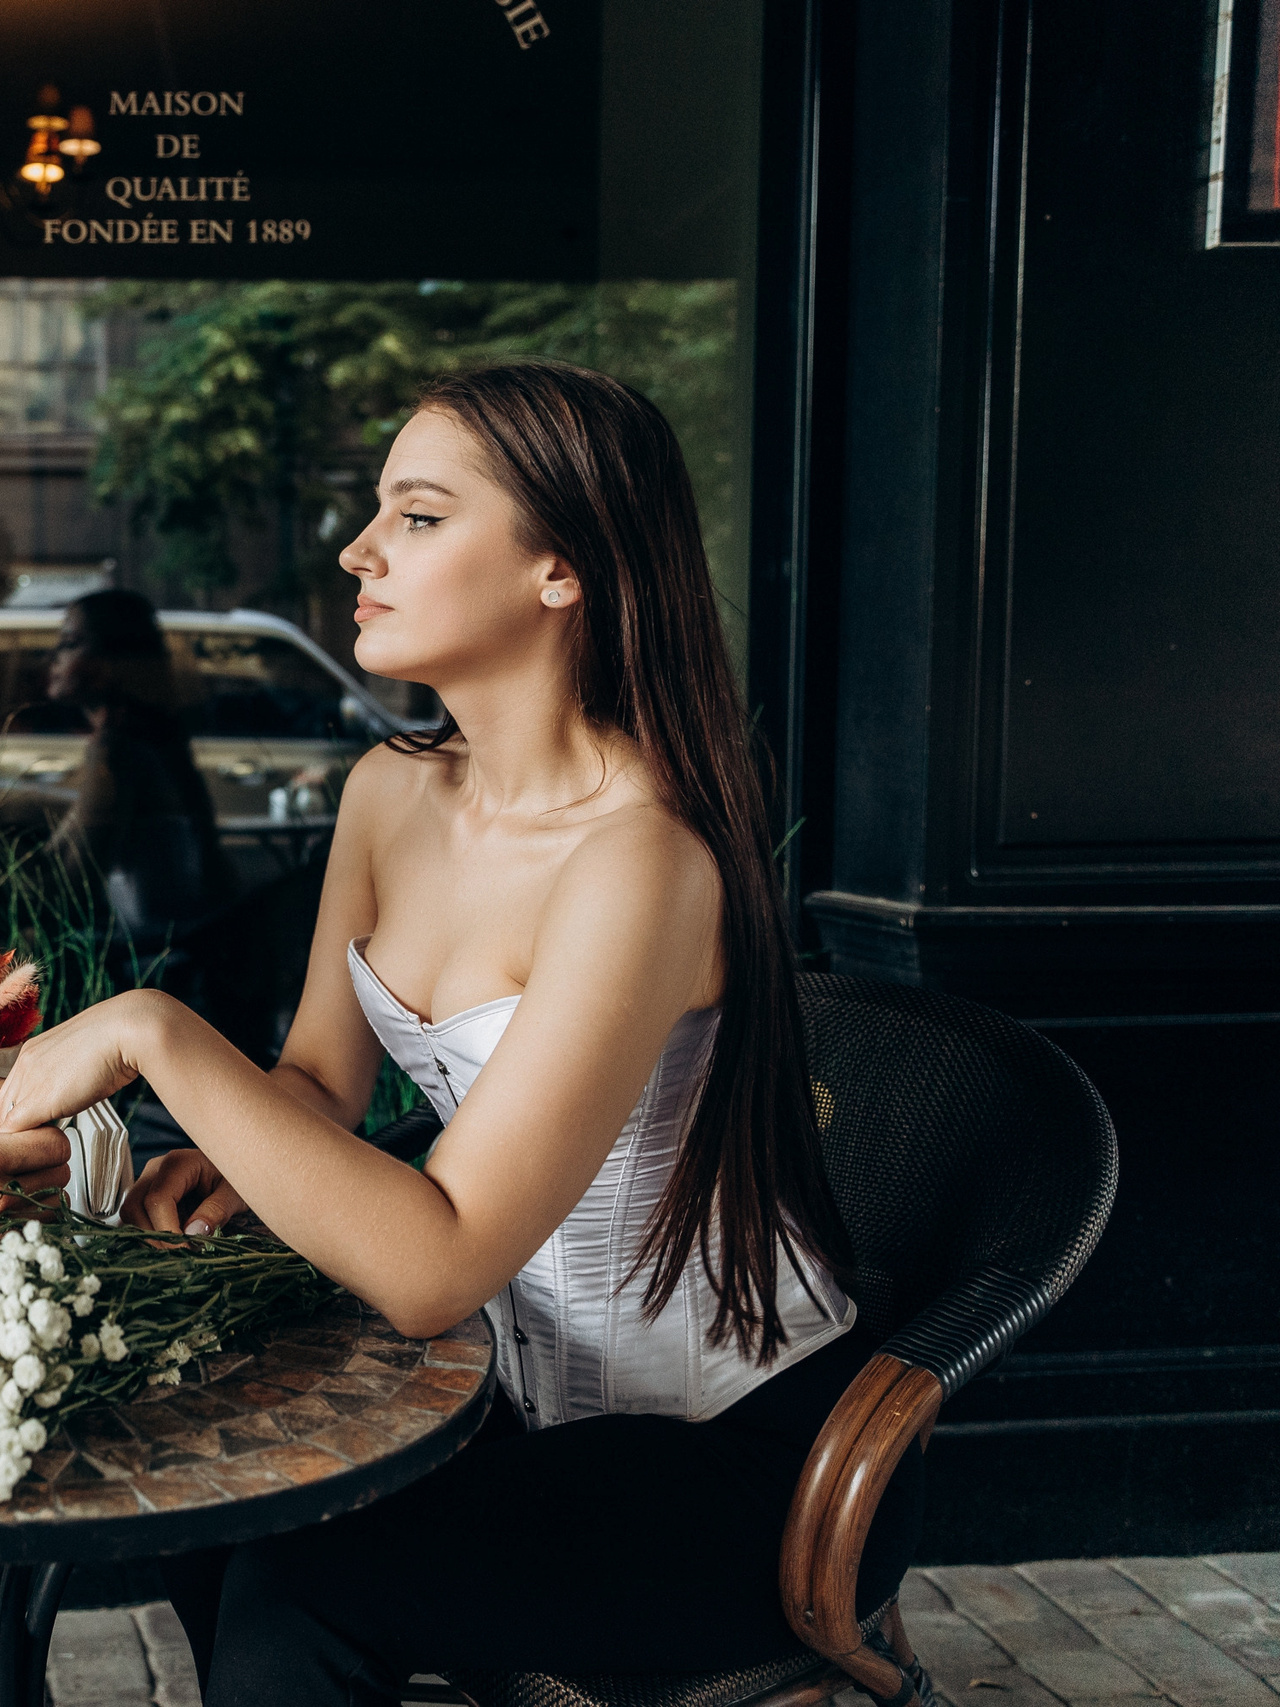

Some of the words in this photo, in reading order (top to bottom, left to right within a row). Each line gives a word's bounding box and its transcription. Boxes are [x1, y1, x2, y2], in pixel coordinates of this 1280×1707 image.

[109, 91, 245, 117] MAISON
[156, 134, 202, 159] DE
[105, 170, 252, 209] QUALITÉ
[43, 213, 180, 244] FONDÉE
[189, 219, 234, 244] EN
[247, 219, 312, 244] 1889
